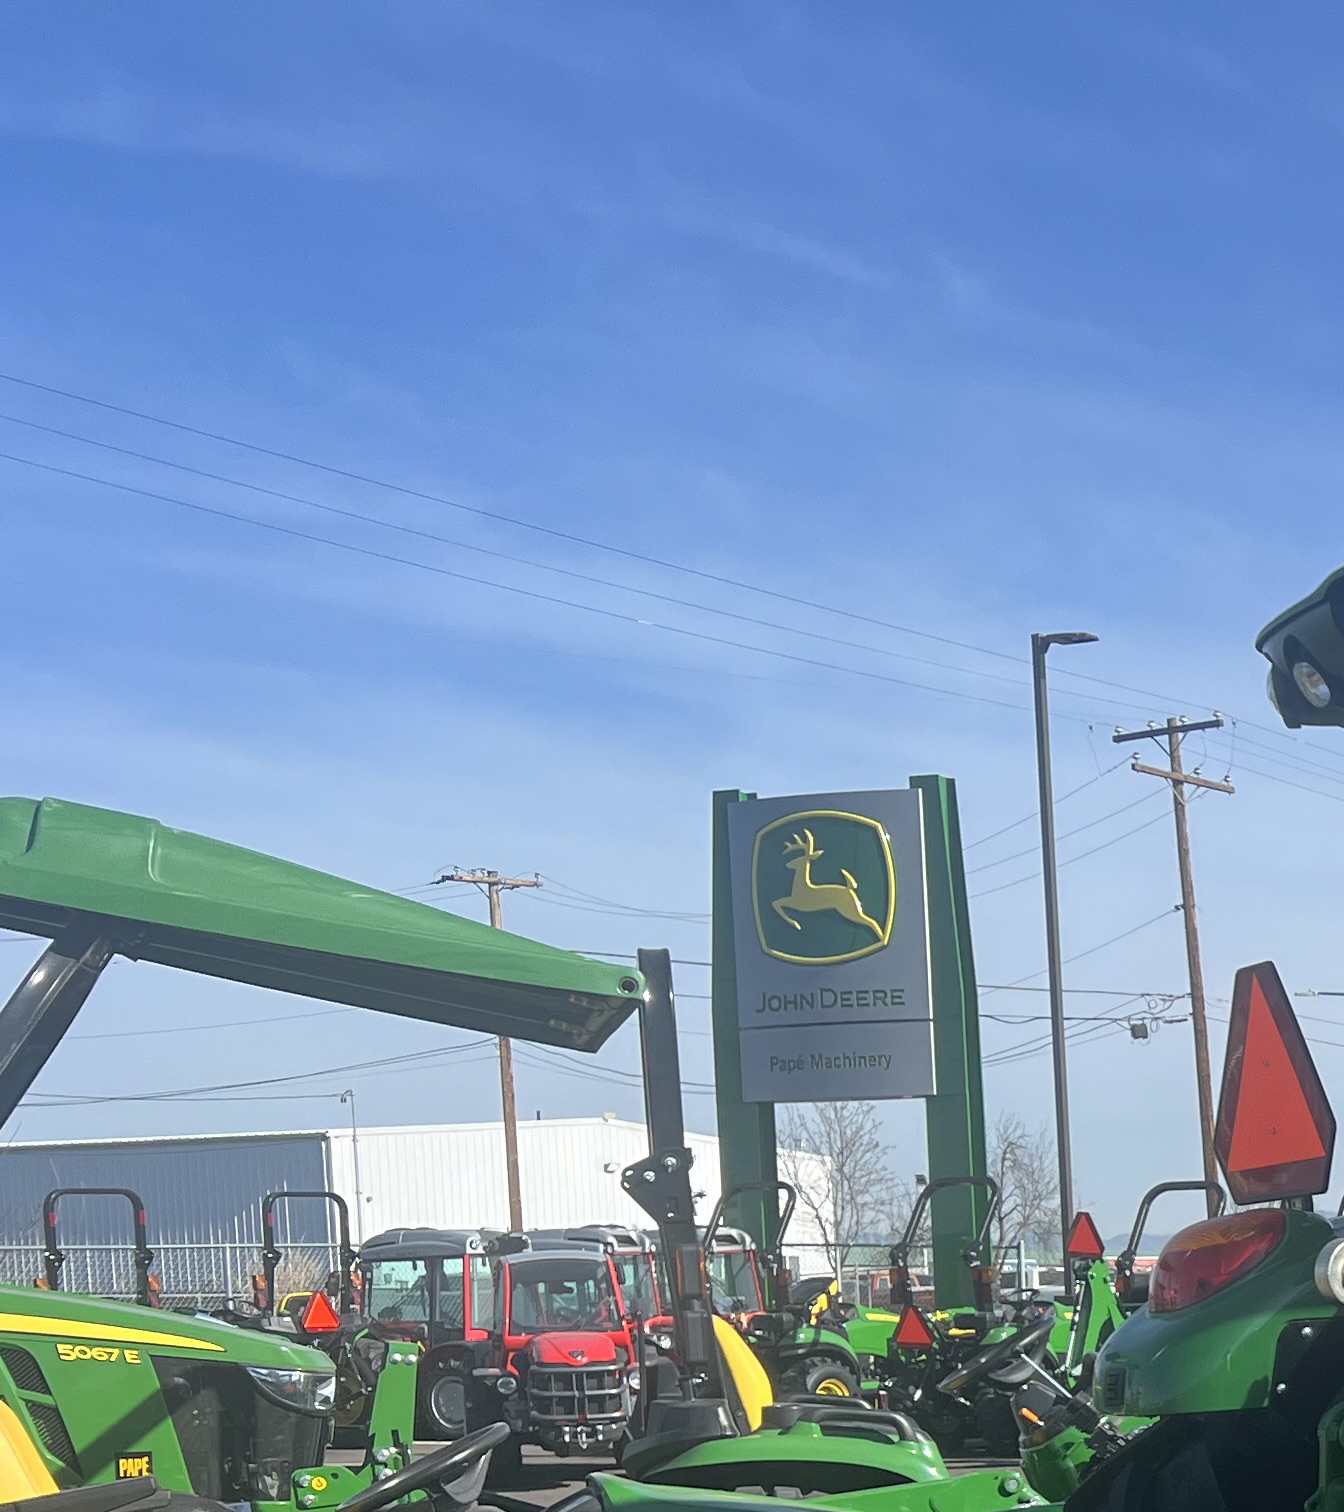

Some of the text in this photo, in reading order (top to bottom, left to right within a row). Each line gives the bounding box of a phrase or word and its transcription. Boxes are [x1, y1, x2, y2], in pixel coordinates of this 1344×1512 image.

[810, 1051, 892, 1071] Machinery
[56, 1343, 142, 1364] 5067 E
